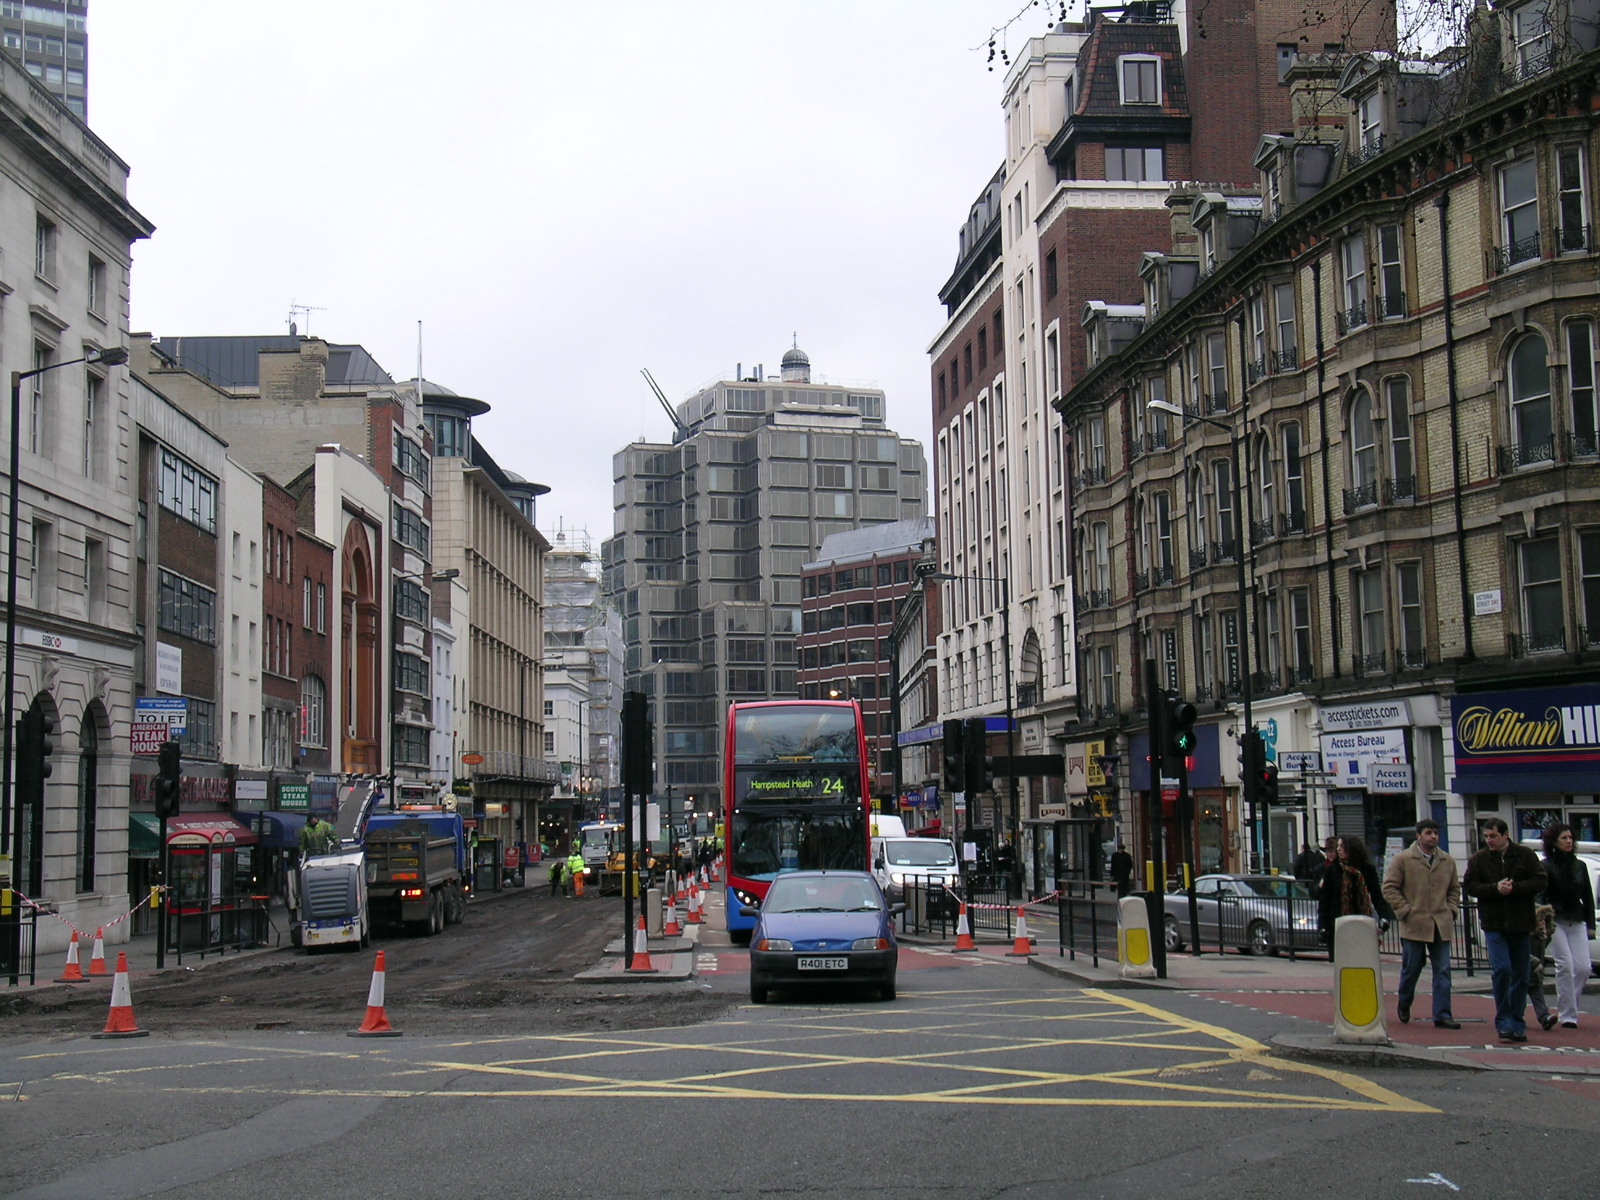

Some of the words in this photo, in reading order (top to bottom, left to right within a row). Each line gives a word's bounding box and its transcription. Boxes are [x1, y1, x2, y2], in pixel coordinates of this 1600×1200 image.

[138, 714, 157, 723] TO
[1327, 705, 1400, 723] accesstickets.com
[131, 723, 166, 731] AMERICAN
[1457, 706, 1561, 752] William
[1561, 704, 1600, 745] HI
[131, 731, 166, 742] STEAK
[1331, 737, 1355, 749] Access
[1357, 735, 1386, 747] Bureau
[131, 741, 161, 753] HOUS
[1376, 770, 1407, 778] Access
[750, 780, 790, 791] Hampstead
[792, 779, 814, 788] Heath
[821, 778, 844, 794] 24
[1376, 780, 1408, 788] Tickets
[800, 959, 823, 968] R401
[824, 959, 845, 968] ETC
